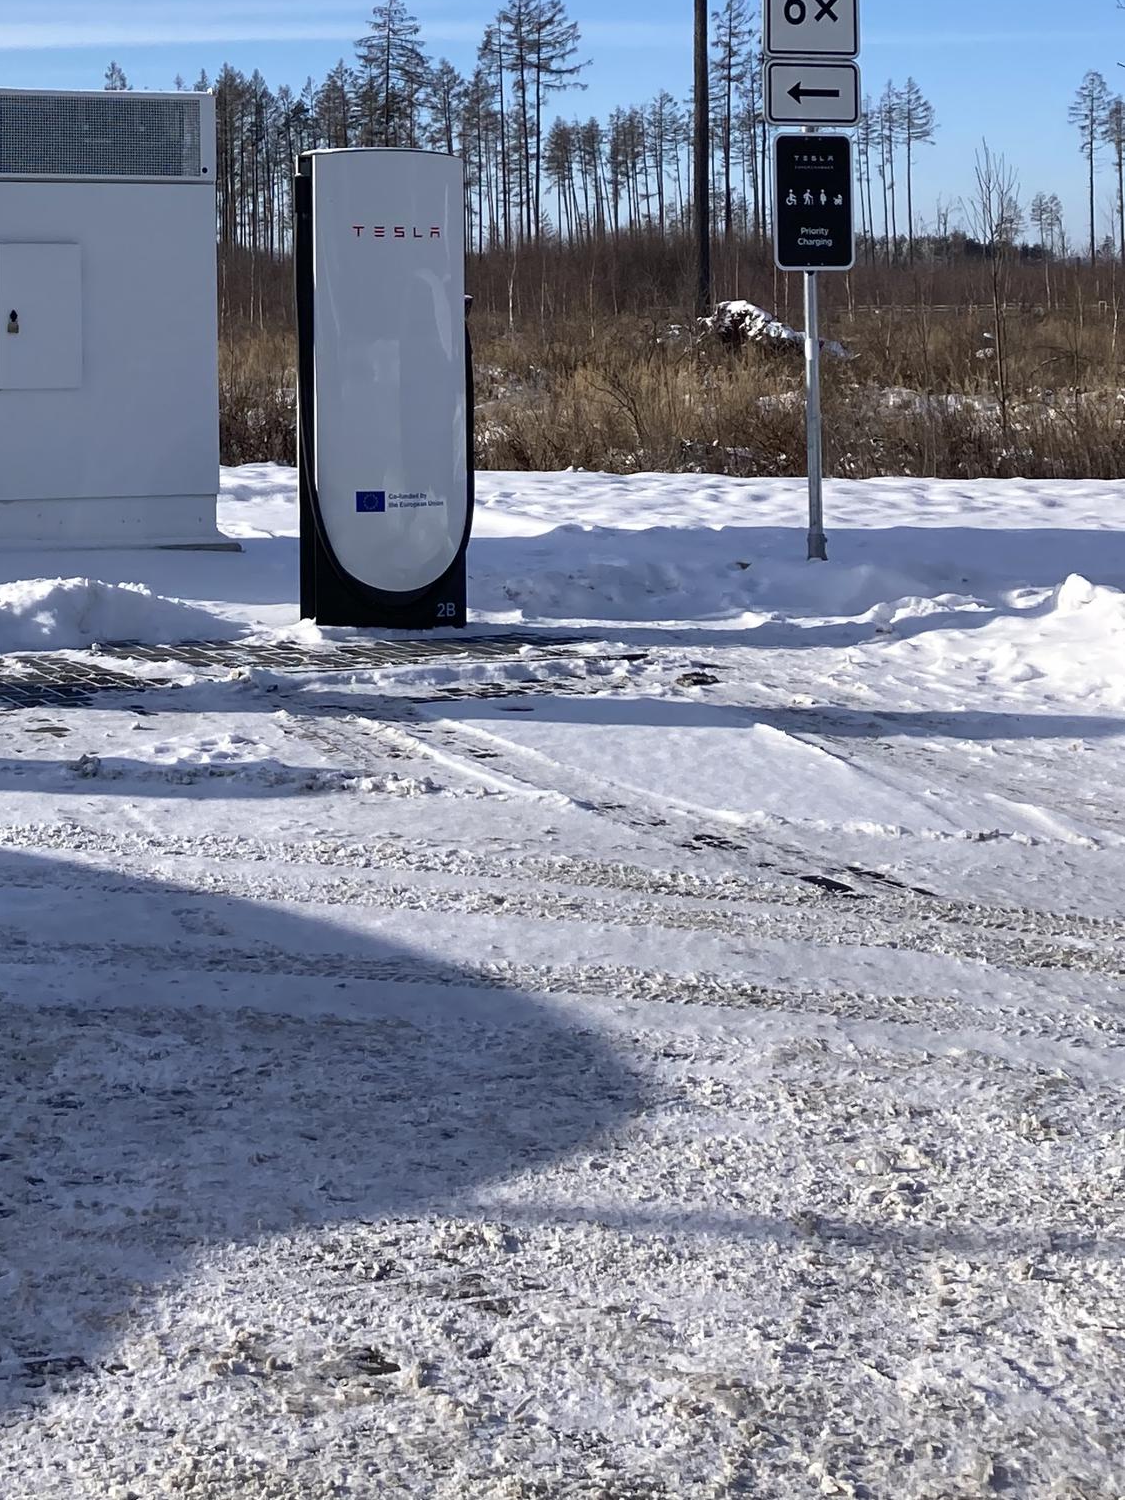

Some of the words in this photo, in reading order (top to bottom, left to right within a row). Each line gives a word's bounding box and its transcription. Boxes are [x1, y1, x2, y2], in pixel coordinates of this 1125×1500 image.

[352, 226, 440, 238] TESLA
[800, 227, 828, 236] Priority
[797, 237, 833, 247] Charging
[436, 602, 456, 617] 2B
